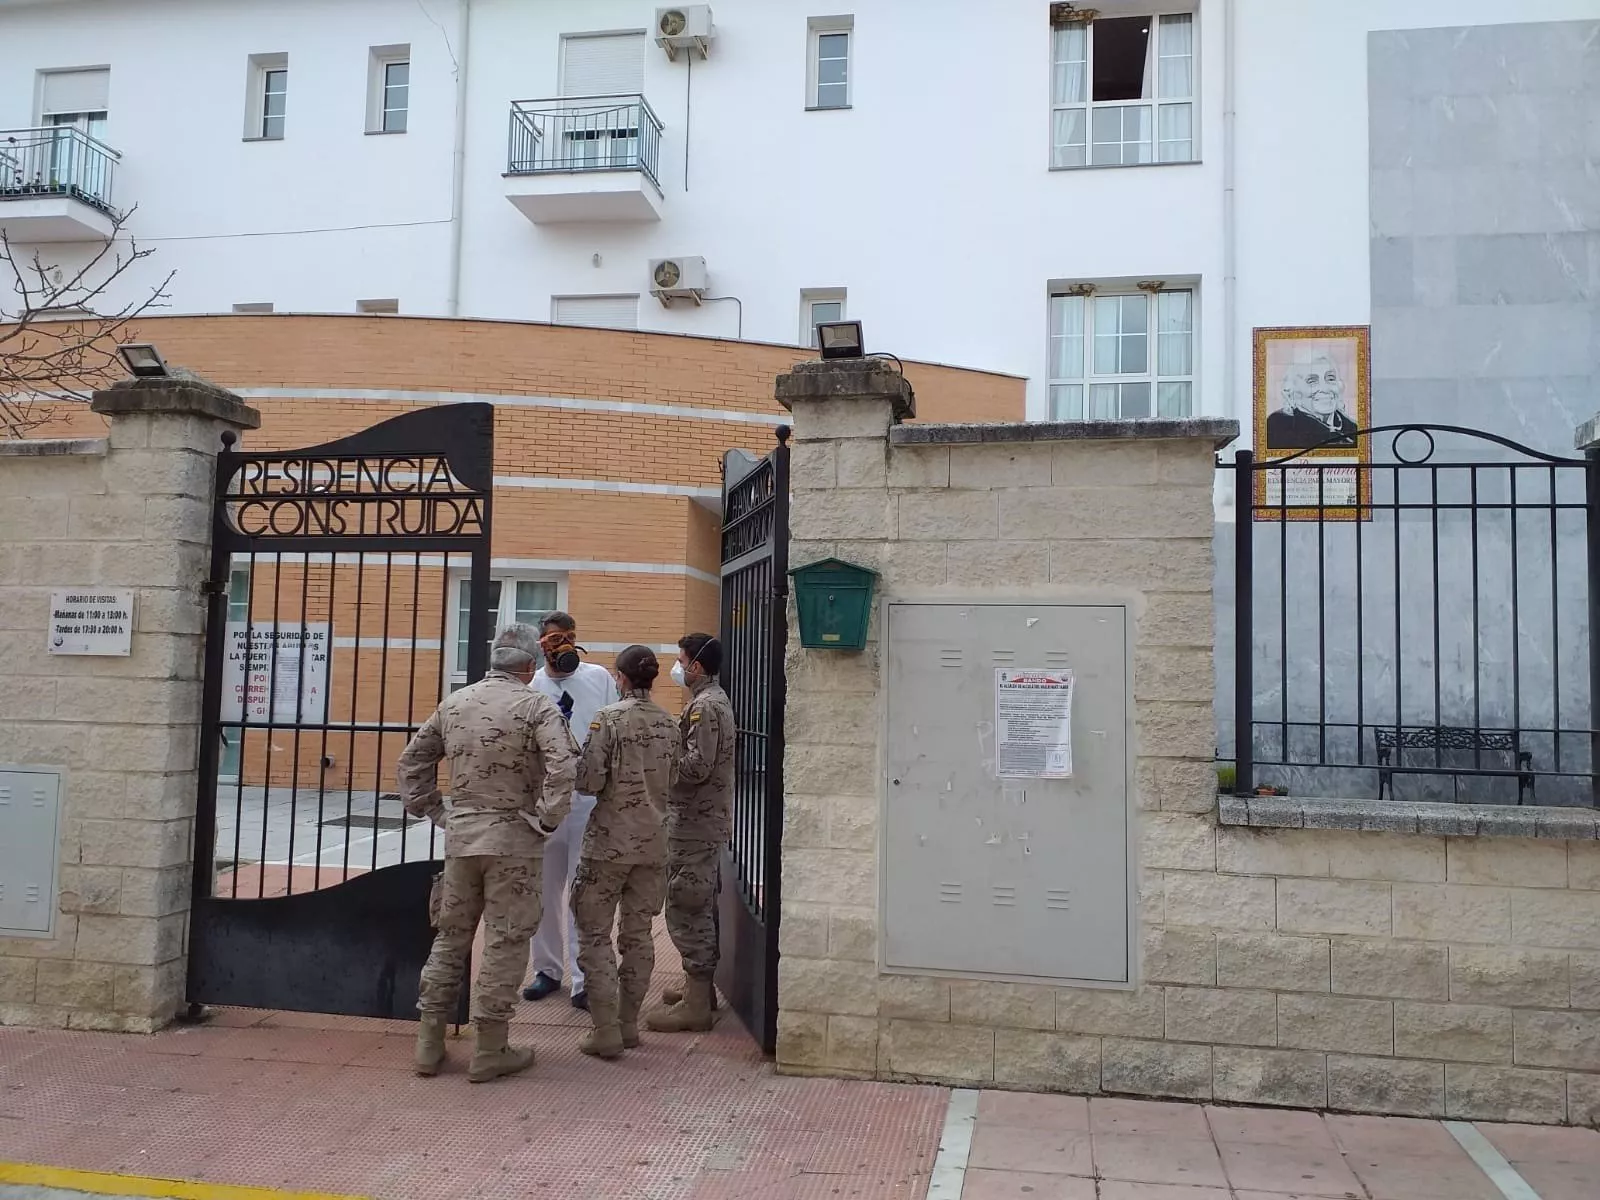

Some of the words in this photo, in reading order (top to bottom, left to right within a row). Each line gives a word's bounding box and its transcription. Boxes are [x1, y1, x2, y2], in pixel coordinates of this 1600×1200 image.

[241, 458, 454, 494] RESIDENCIA
[237, 499, 484, 535] CONSTRUIDA
[66, 595, 88, 604] HORARIO
[89, 595, 96, 604] DE
[233, 631, 249, 639] PO
[252, 632, 262, 640] LA
[264, 632, 311, 640] SEGURIDD
[312, 632, 324, 640] DE
[229, 652, 240, 660] LA
